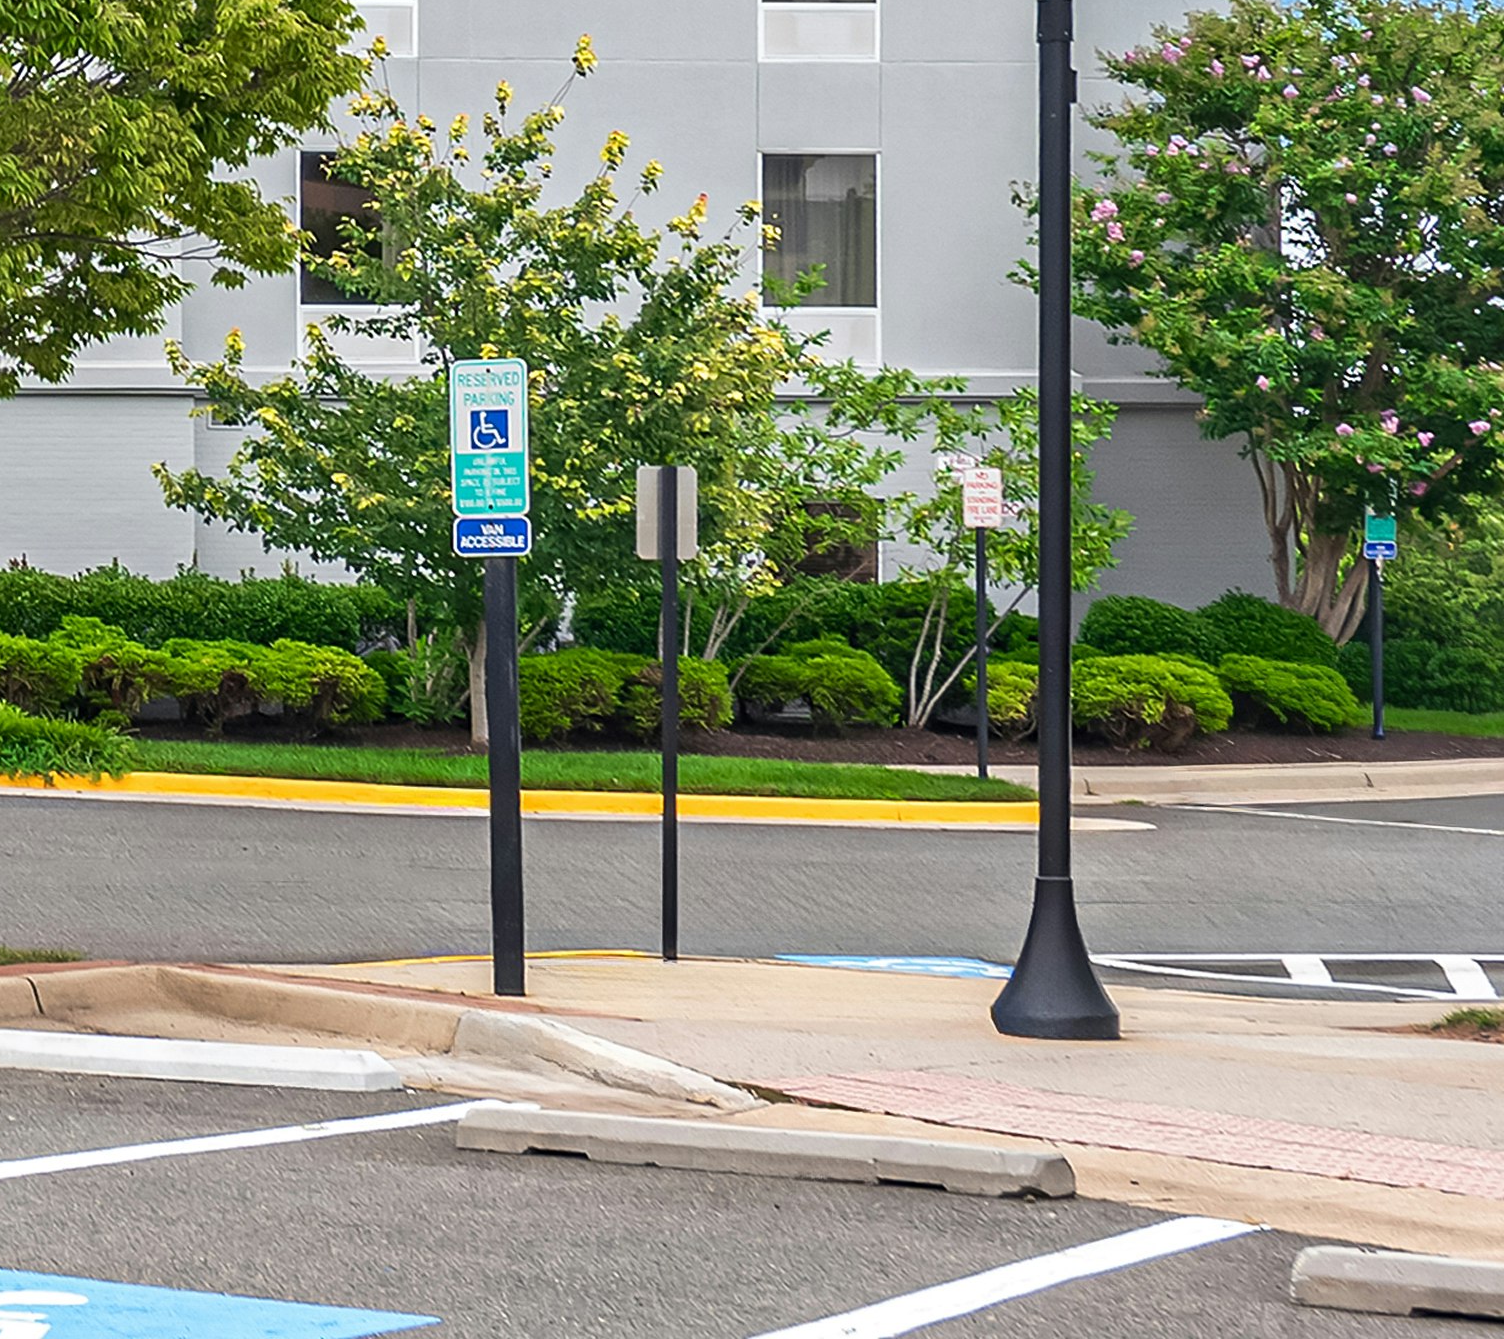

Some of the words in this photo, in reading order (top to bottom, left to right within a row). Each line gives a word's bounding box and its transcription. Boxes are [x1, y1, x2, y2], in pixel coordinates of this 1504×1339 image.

[458, 372, 520, 387] RESERVED
[1001, 503, 1019, 515] DC
[480, 524, 504, 535] VAN
[460, 535, 526, 548] ACCESSIBLE
